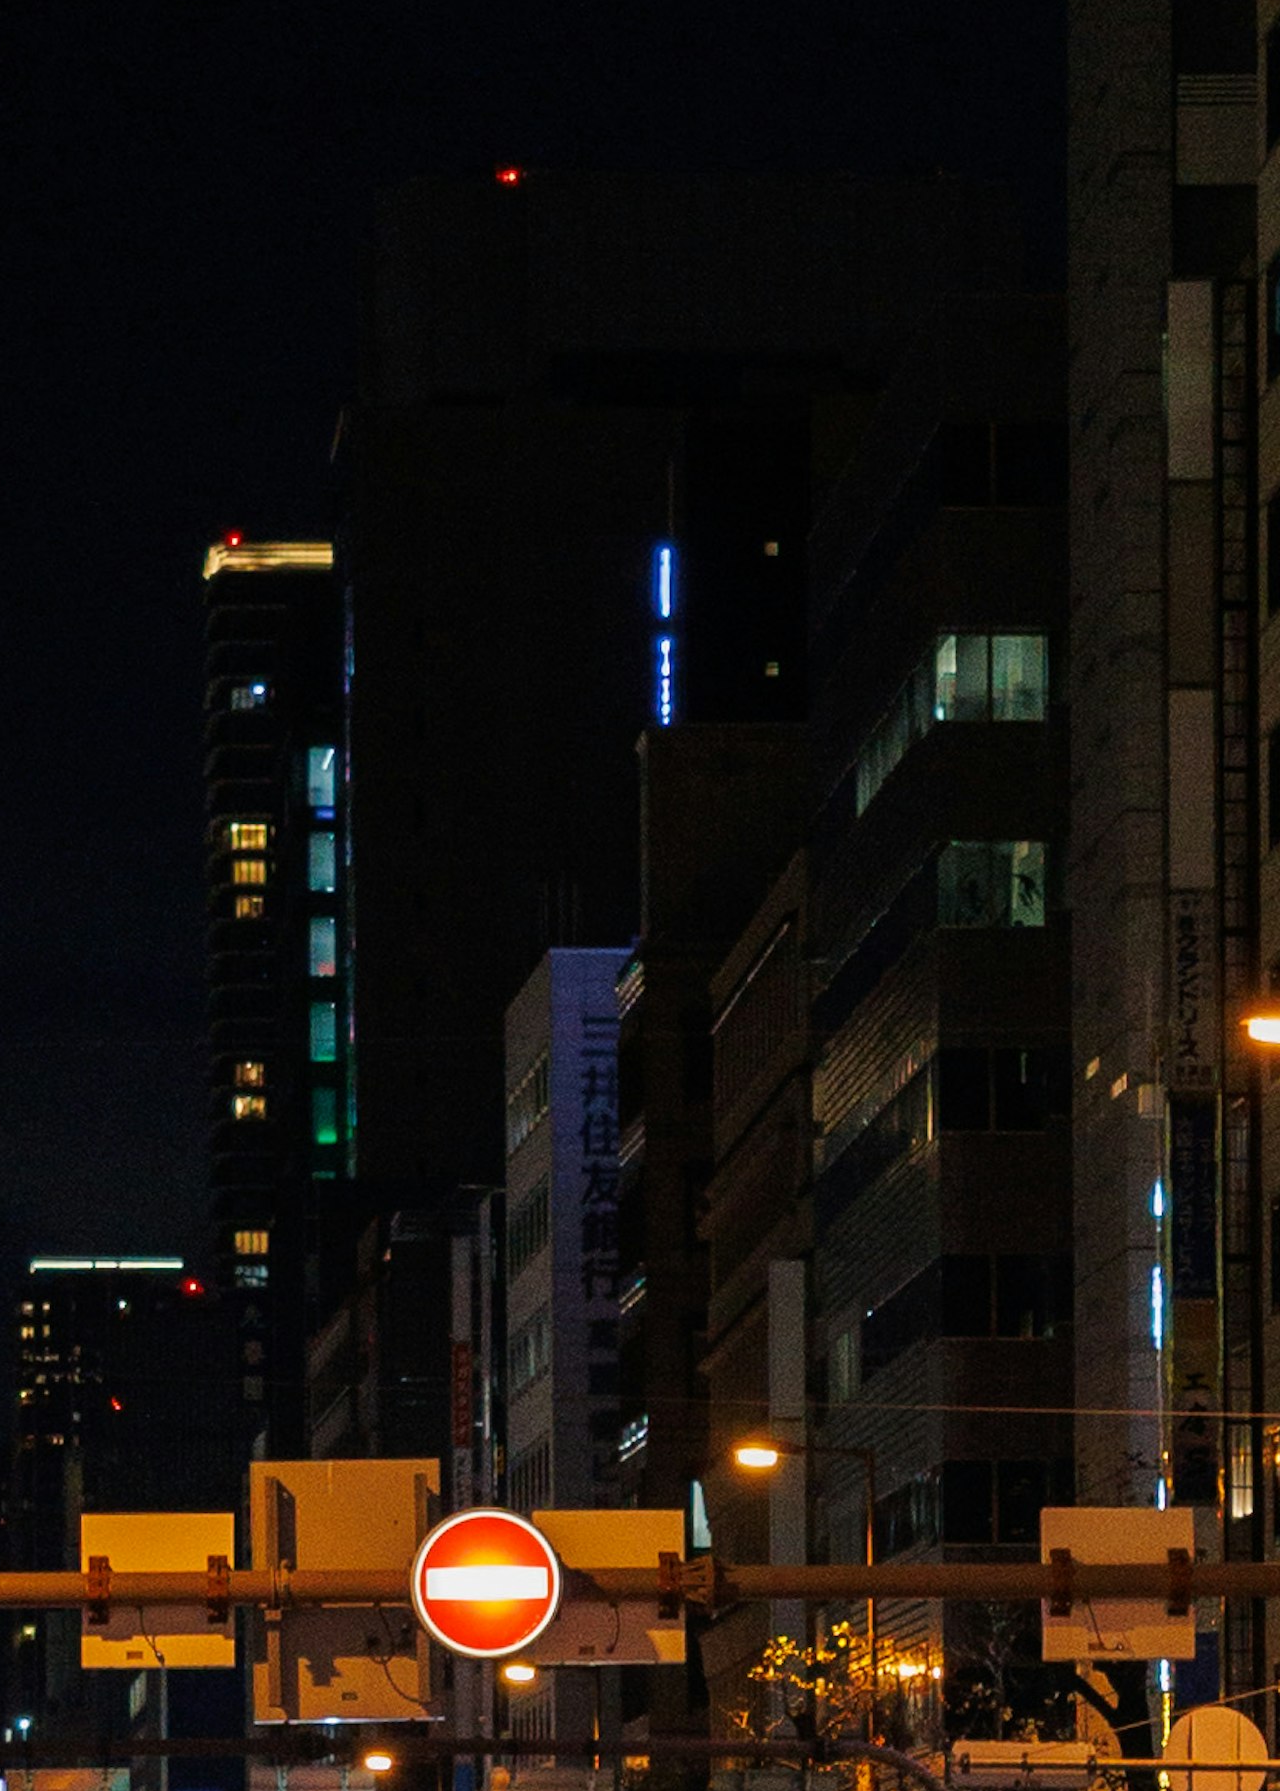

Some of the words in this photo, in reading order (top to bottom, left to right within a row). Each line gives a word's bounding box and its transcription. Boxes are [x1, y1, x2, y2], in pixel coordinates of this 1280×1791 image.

[580, 1015, 620, 1303] 三井住友銀行
